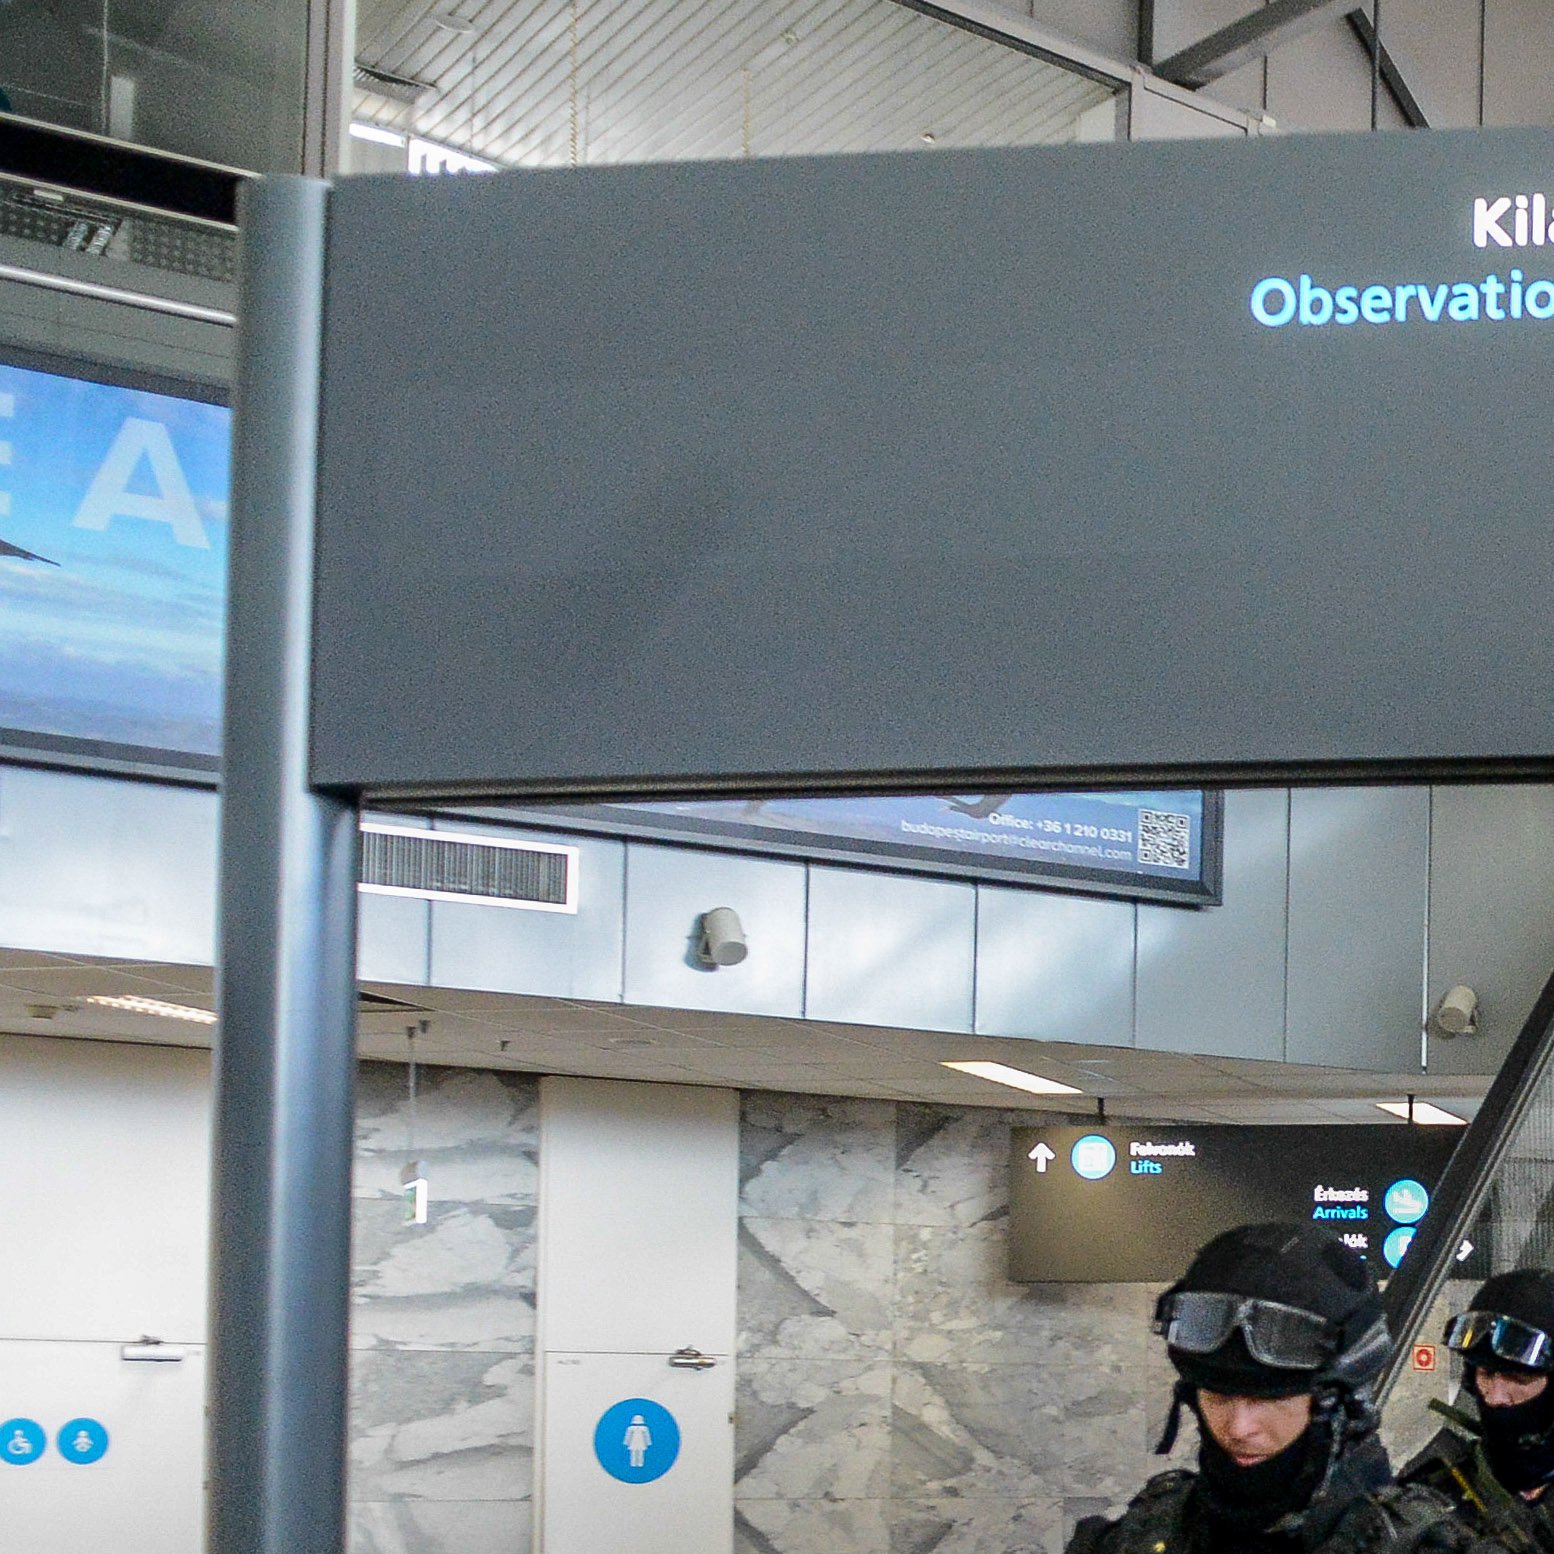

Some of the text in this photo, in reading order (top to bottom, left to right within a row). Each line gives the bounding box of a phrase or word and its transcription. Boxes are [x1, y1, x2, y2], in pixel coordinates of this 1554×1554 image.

[988, 812, 1034, 831] Office:
[1073, 824, 1098, 838] 210
[1130, 1159, 1163, 1175] Lifts
[1312, 1205, 1369, 1220] Arrivals
